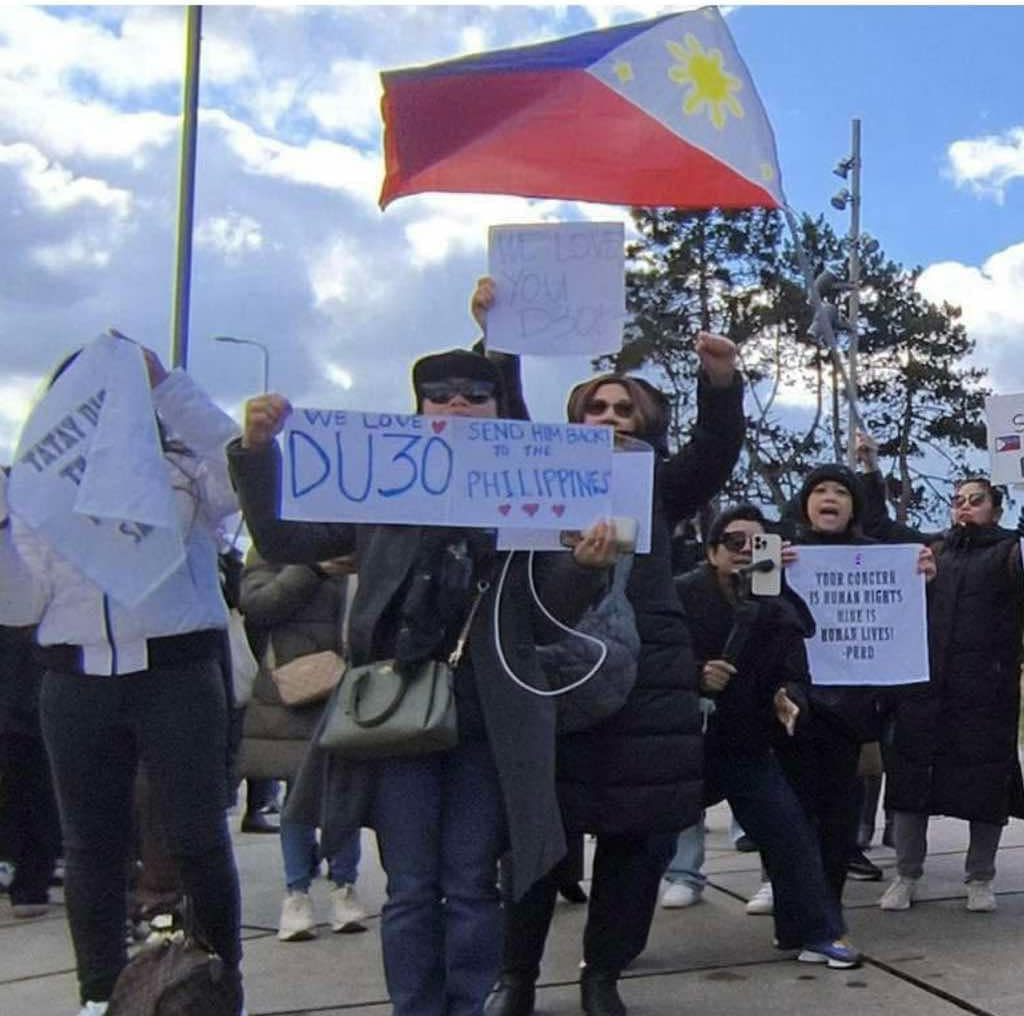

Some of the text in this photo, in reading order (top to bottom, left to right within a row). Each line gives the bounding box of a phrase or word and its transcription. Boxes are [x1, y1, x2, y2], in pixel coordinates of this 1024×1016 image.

[303, 408, 422, 430] WE LOVE
[467, 421, 526, 441] SEND
[531, 423, 561, 442] HIM
[21, 414, 87, 473] TATAY
[493, 444, 552, 457] TO THE
[288, 429, 454, 503] DU30
[466, 467, 612, 499] PHILIPPINES
[815, 570, 897, 587] YOUR CONCERN
[809, 590, 820, 606] IS
[864, 589, 904, 604] RIGHTS
